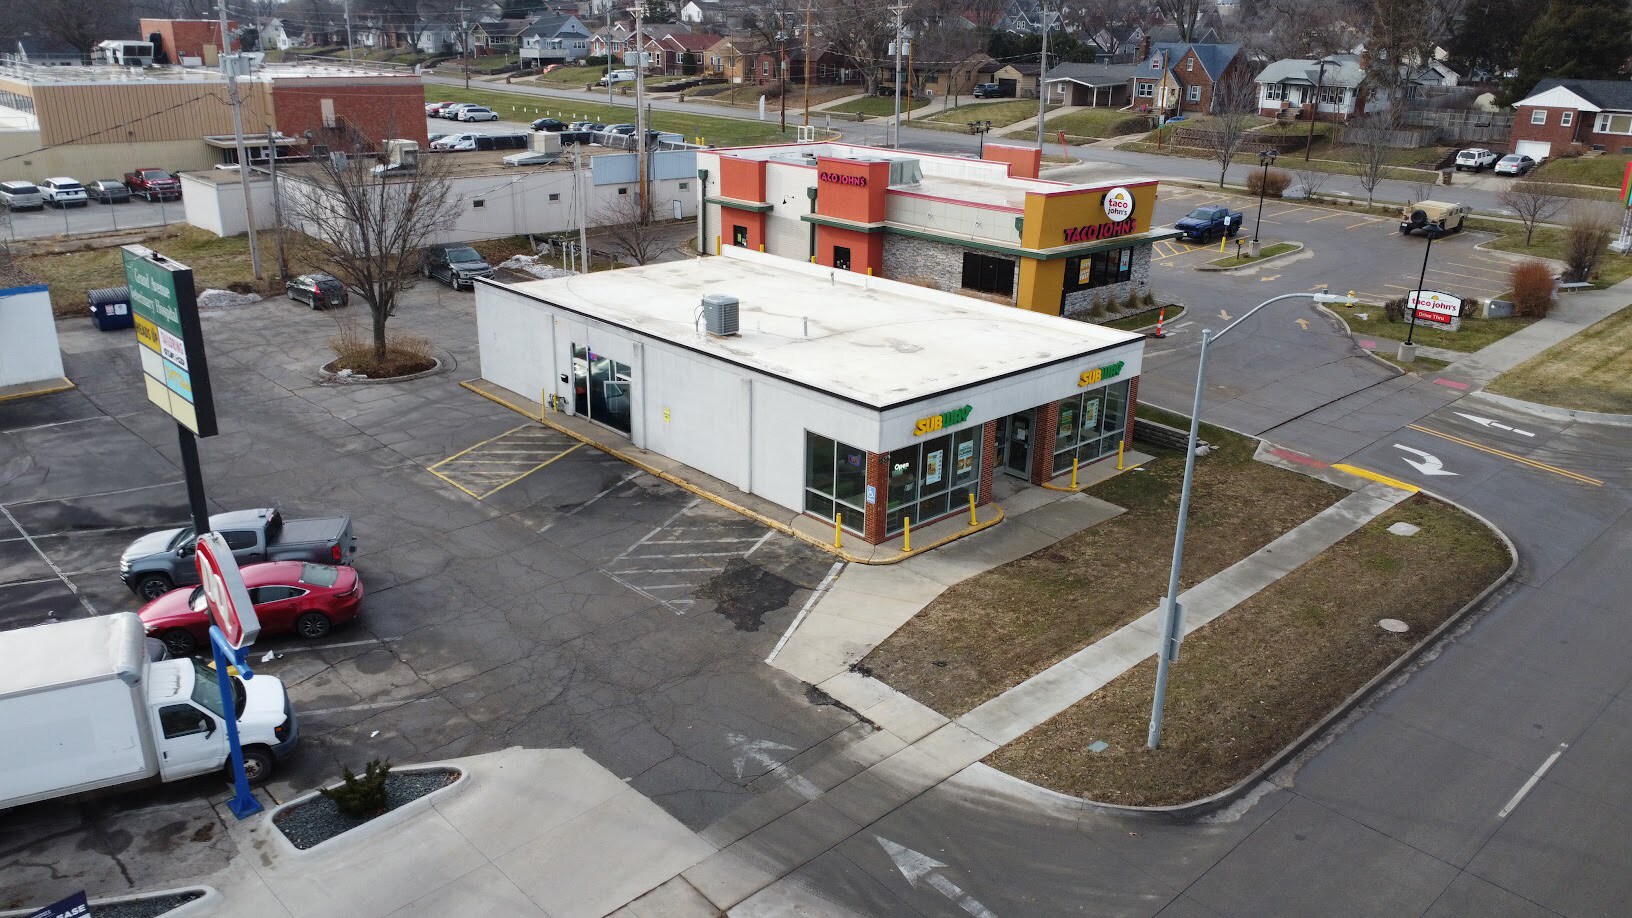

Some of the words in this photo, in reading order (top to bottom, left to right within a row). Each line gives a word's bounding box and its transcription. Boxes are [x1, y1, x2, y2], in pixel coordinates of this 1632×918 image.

[1108, 198, 1128, 209] taco
[1107, 206, 1128, 216] john's
[1064, 225, 1098, 243] TACO
[155, 299, 179, 323] Hospital
[1432, 301, 1456, 311] john's
[1418, 311, 1432, 319] Drive
[1078, 360, 1125, 388] SUBWAY
[913, 404, 973, 437] SUBWAY
[894, 462, 910, 471] Open
